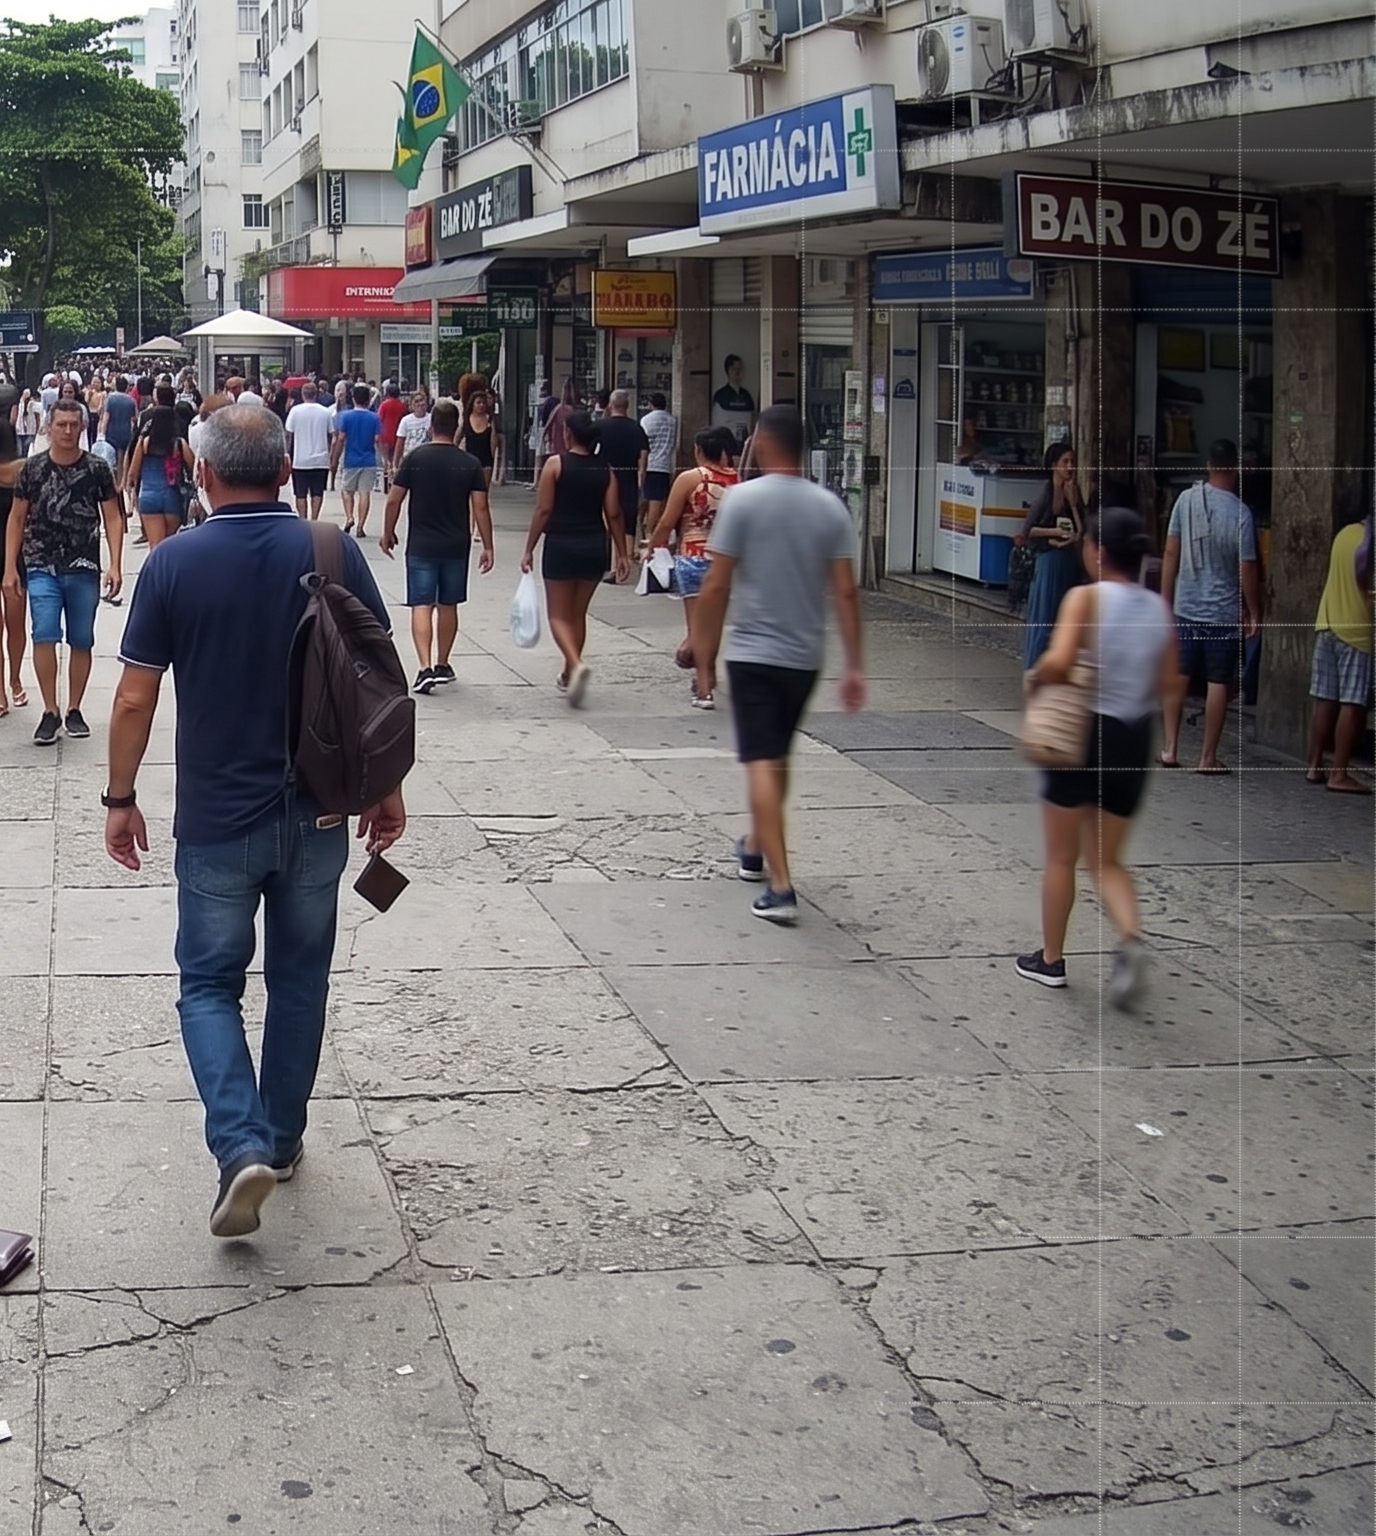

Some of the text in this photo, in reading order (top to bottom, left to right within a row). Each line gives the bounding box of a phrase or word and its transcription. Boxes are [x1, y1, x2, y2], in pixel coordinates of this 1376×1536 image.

[703, 118, 839, 204] FARMÁCIA
[440, 204, 460, 239] BAR
[462, 198, 475, 232] DO
[477, 185, 493, 228] ZÉ
[1030, 193, 1271, 259] BAR DO ZÉ
